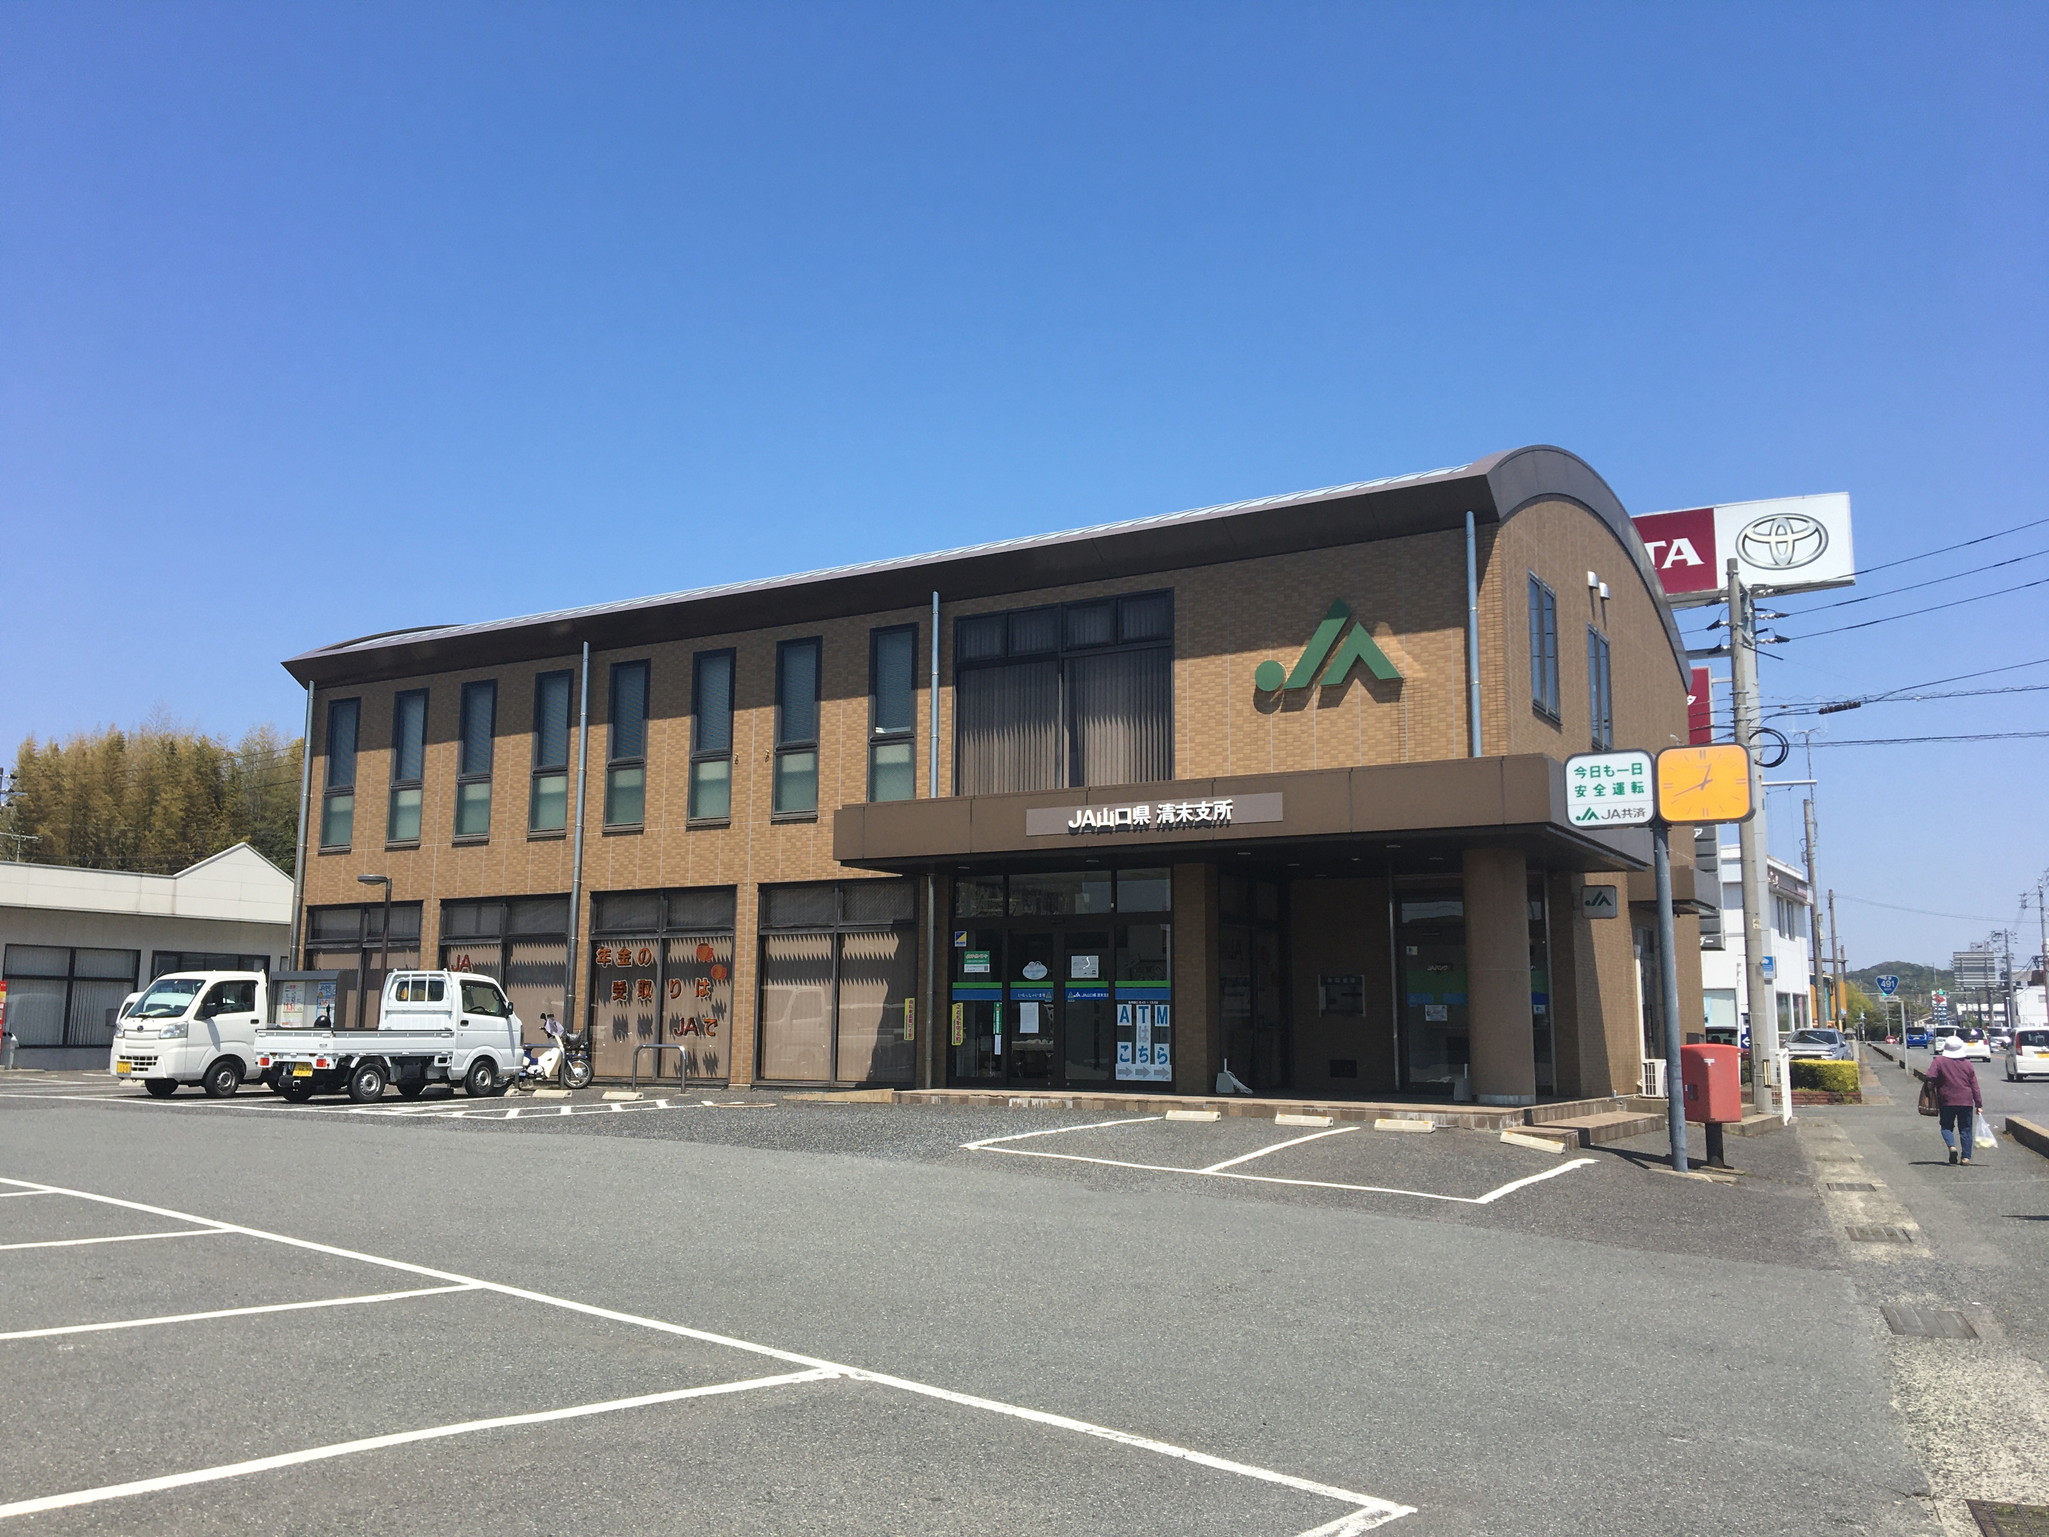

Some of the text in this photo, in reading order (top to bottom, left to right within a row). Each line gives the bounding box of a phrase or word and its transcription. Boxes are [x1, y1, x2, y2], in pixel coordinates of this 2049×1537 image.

[1573, 762, 1643, 780] 今日も一日
[1574, 781, 1645, 798] 安全運転
[1067, 799, 1234, 829] JA山口県 清末支所
[1601, 807, 1646, 821] JA共済
[450, 953, 474, 973] JA
[595, 946, 653, 968] 年金の
[611, 977, 713, 1001] 受取りは
[1880, 979, 1895, 988] 491
[1119, 1005, 1168, 1025] ATM
[673, 1016, 719, 1037] JAで
[1138, 1025, 1149, 1042] は
[1119, 1044, 1168, 1065] こちら
